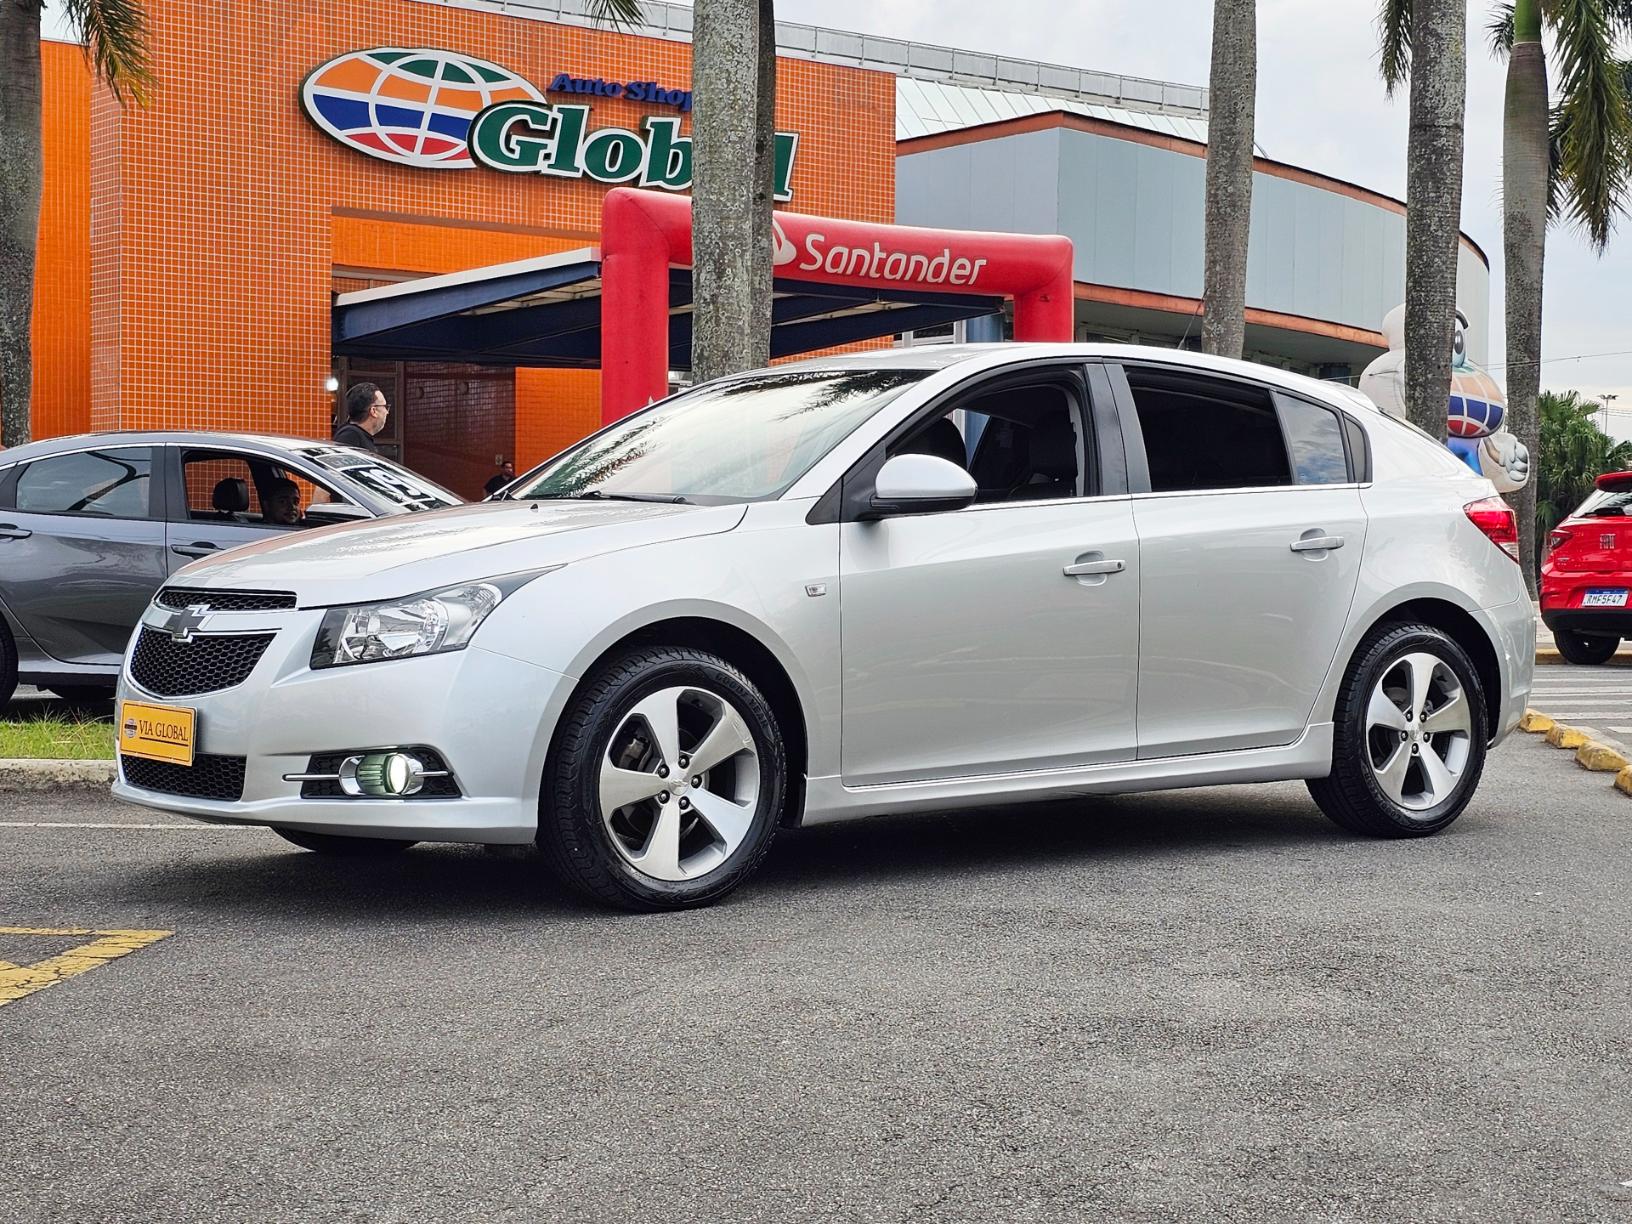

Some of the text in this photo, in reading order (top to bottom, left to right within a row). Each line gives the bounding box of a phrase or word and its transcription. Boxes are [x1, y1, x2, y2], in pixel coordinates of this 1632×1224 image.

[546, 73, 624, 97] Auto
[472, 104, 799, 202] Globl
[800, 233, 987, 285] Santander
[138, 719, 189, 742] VIA GLOBAL
